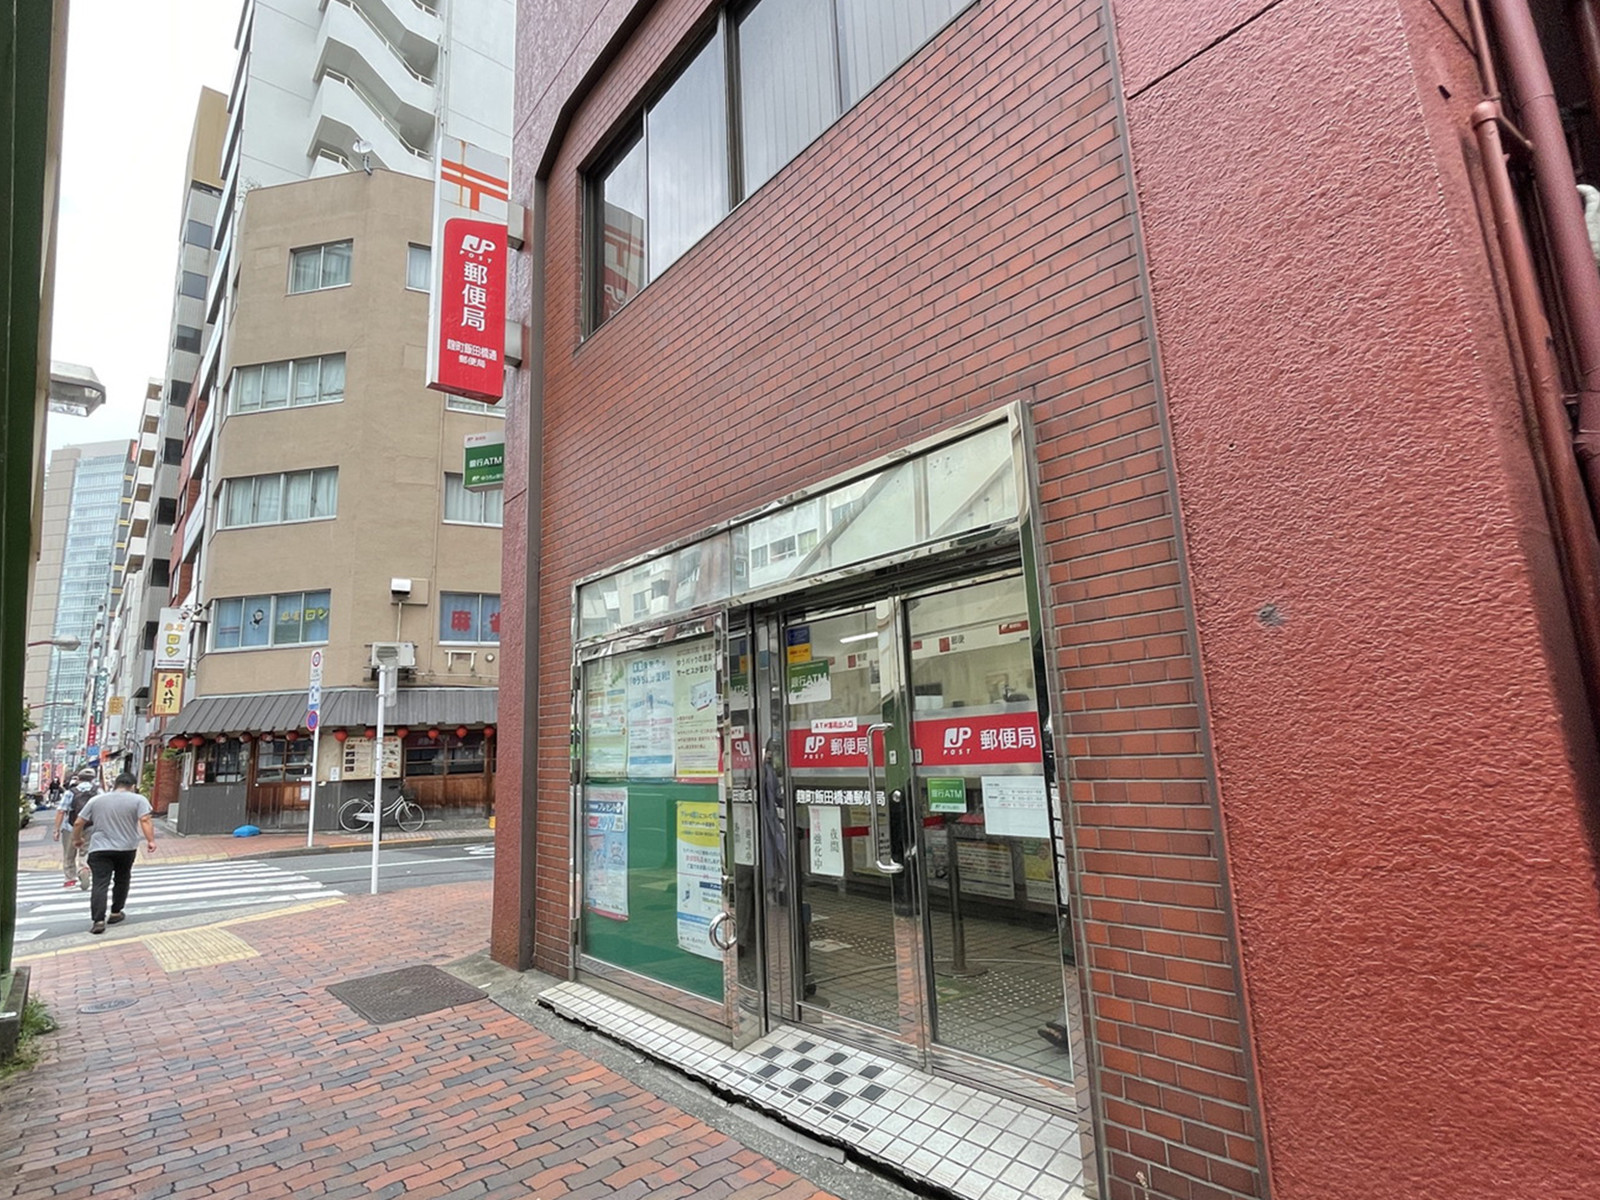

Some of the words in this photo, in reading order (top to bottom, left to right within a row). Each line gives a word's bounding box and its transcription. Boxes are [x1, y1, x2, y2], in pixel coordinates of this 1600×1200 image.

[459, 250, 493, 264] POST
[461, 261, 488, 332] 郵便局
[458, 354, 487, 369] 郵便局
[469, 456, 503, 468] 銀行ATM
[980, 727, 1036, 750] 郵便局
[830, 737, 868, 756] 郵便局
[943, 748, 971, 756] POST
[931, 789, 963, 799] 銀行ATM
